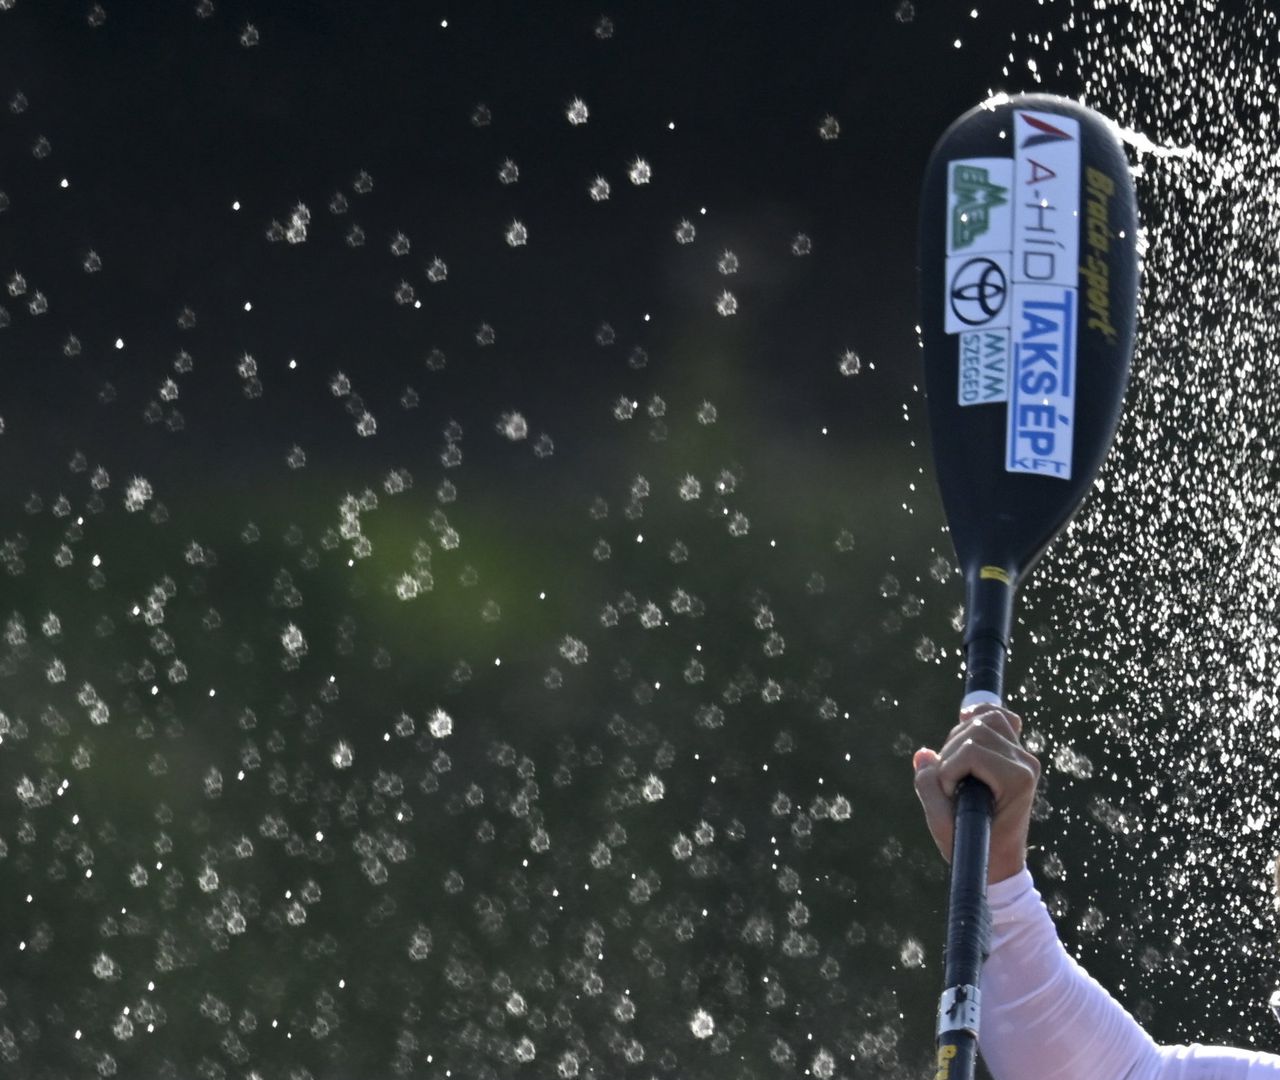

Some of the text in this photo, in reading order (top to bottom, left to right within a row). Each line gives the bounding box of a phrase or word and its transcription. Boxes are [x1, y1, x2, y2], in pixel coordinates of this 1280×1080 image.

[1023, 158, 1066, 281] A-HÍD
[962, 336, 980, 402] SZEGED
[983, 334, 1005, 399] MVM
